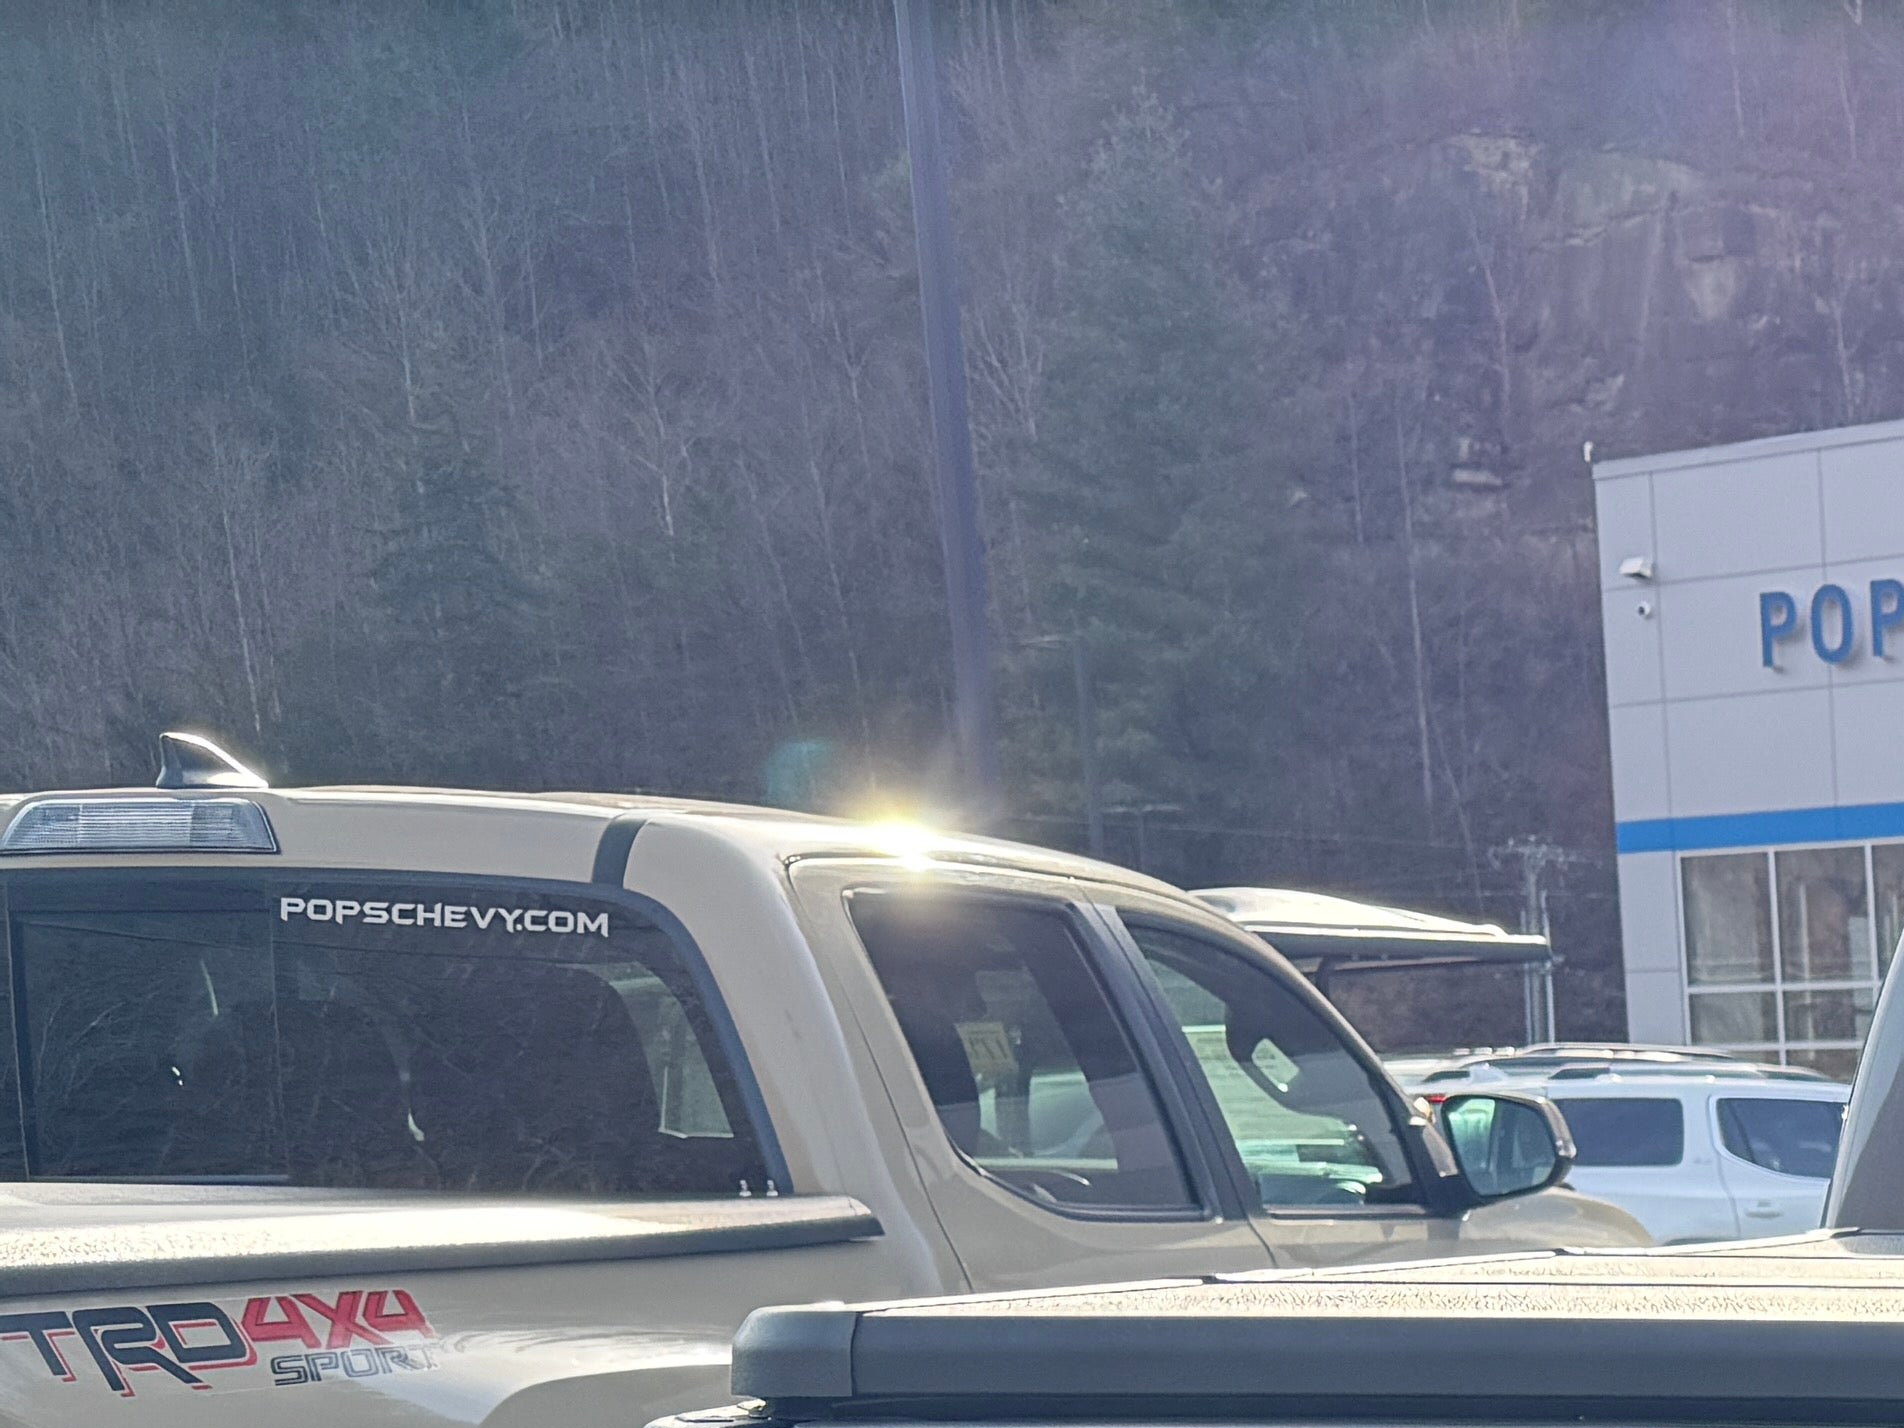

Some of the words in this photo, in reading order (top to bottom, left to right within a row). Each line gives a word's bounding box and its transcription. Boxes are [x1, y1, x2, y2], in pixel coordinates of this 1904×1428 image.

[280, 896, 609, 938] POPSCHEVY.COM
[0, 1306, 259, 1398] TRD
[272, 1342, 440, 1386] SPORT
